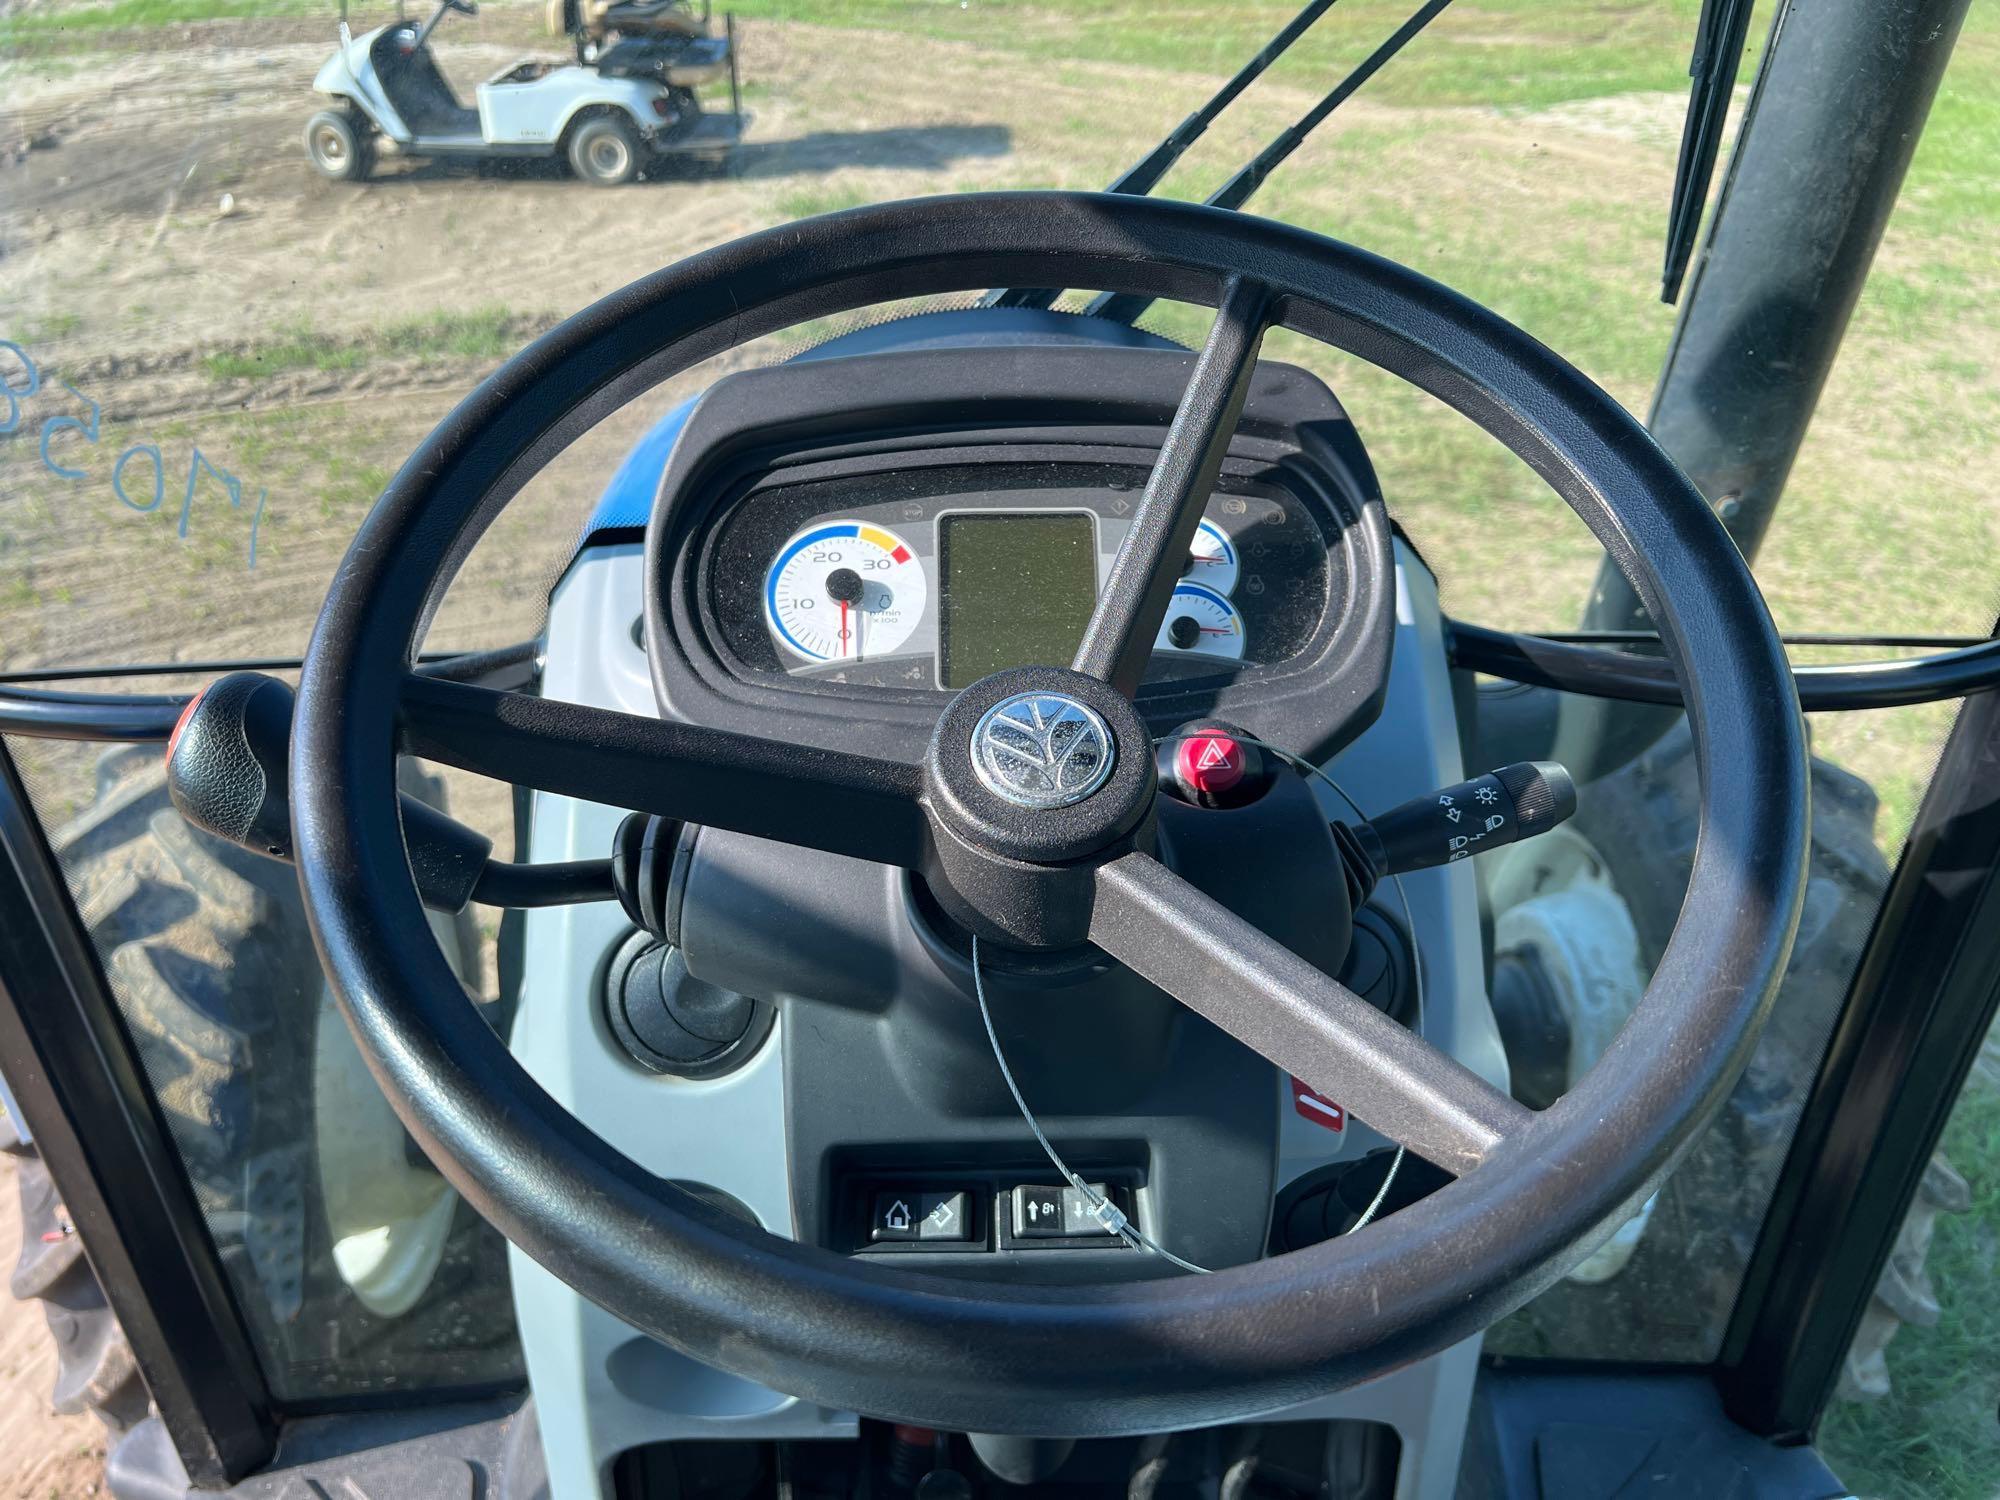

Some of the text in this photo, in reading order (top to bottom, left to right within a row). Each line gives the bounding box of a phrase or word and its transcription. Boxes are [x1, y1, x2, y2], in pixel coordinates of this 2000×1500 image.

[813, 551, 842, 563] 20
[864, 559, 891, 571] 30
[793, 598, 815, 610] 10
[838, 629, 852, 640] 0
